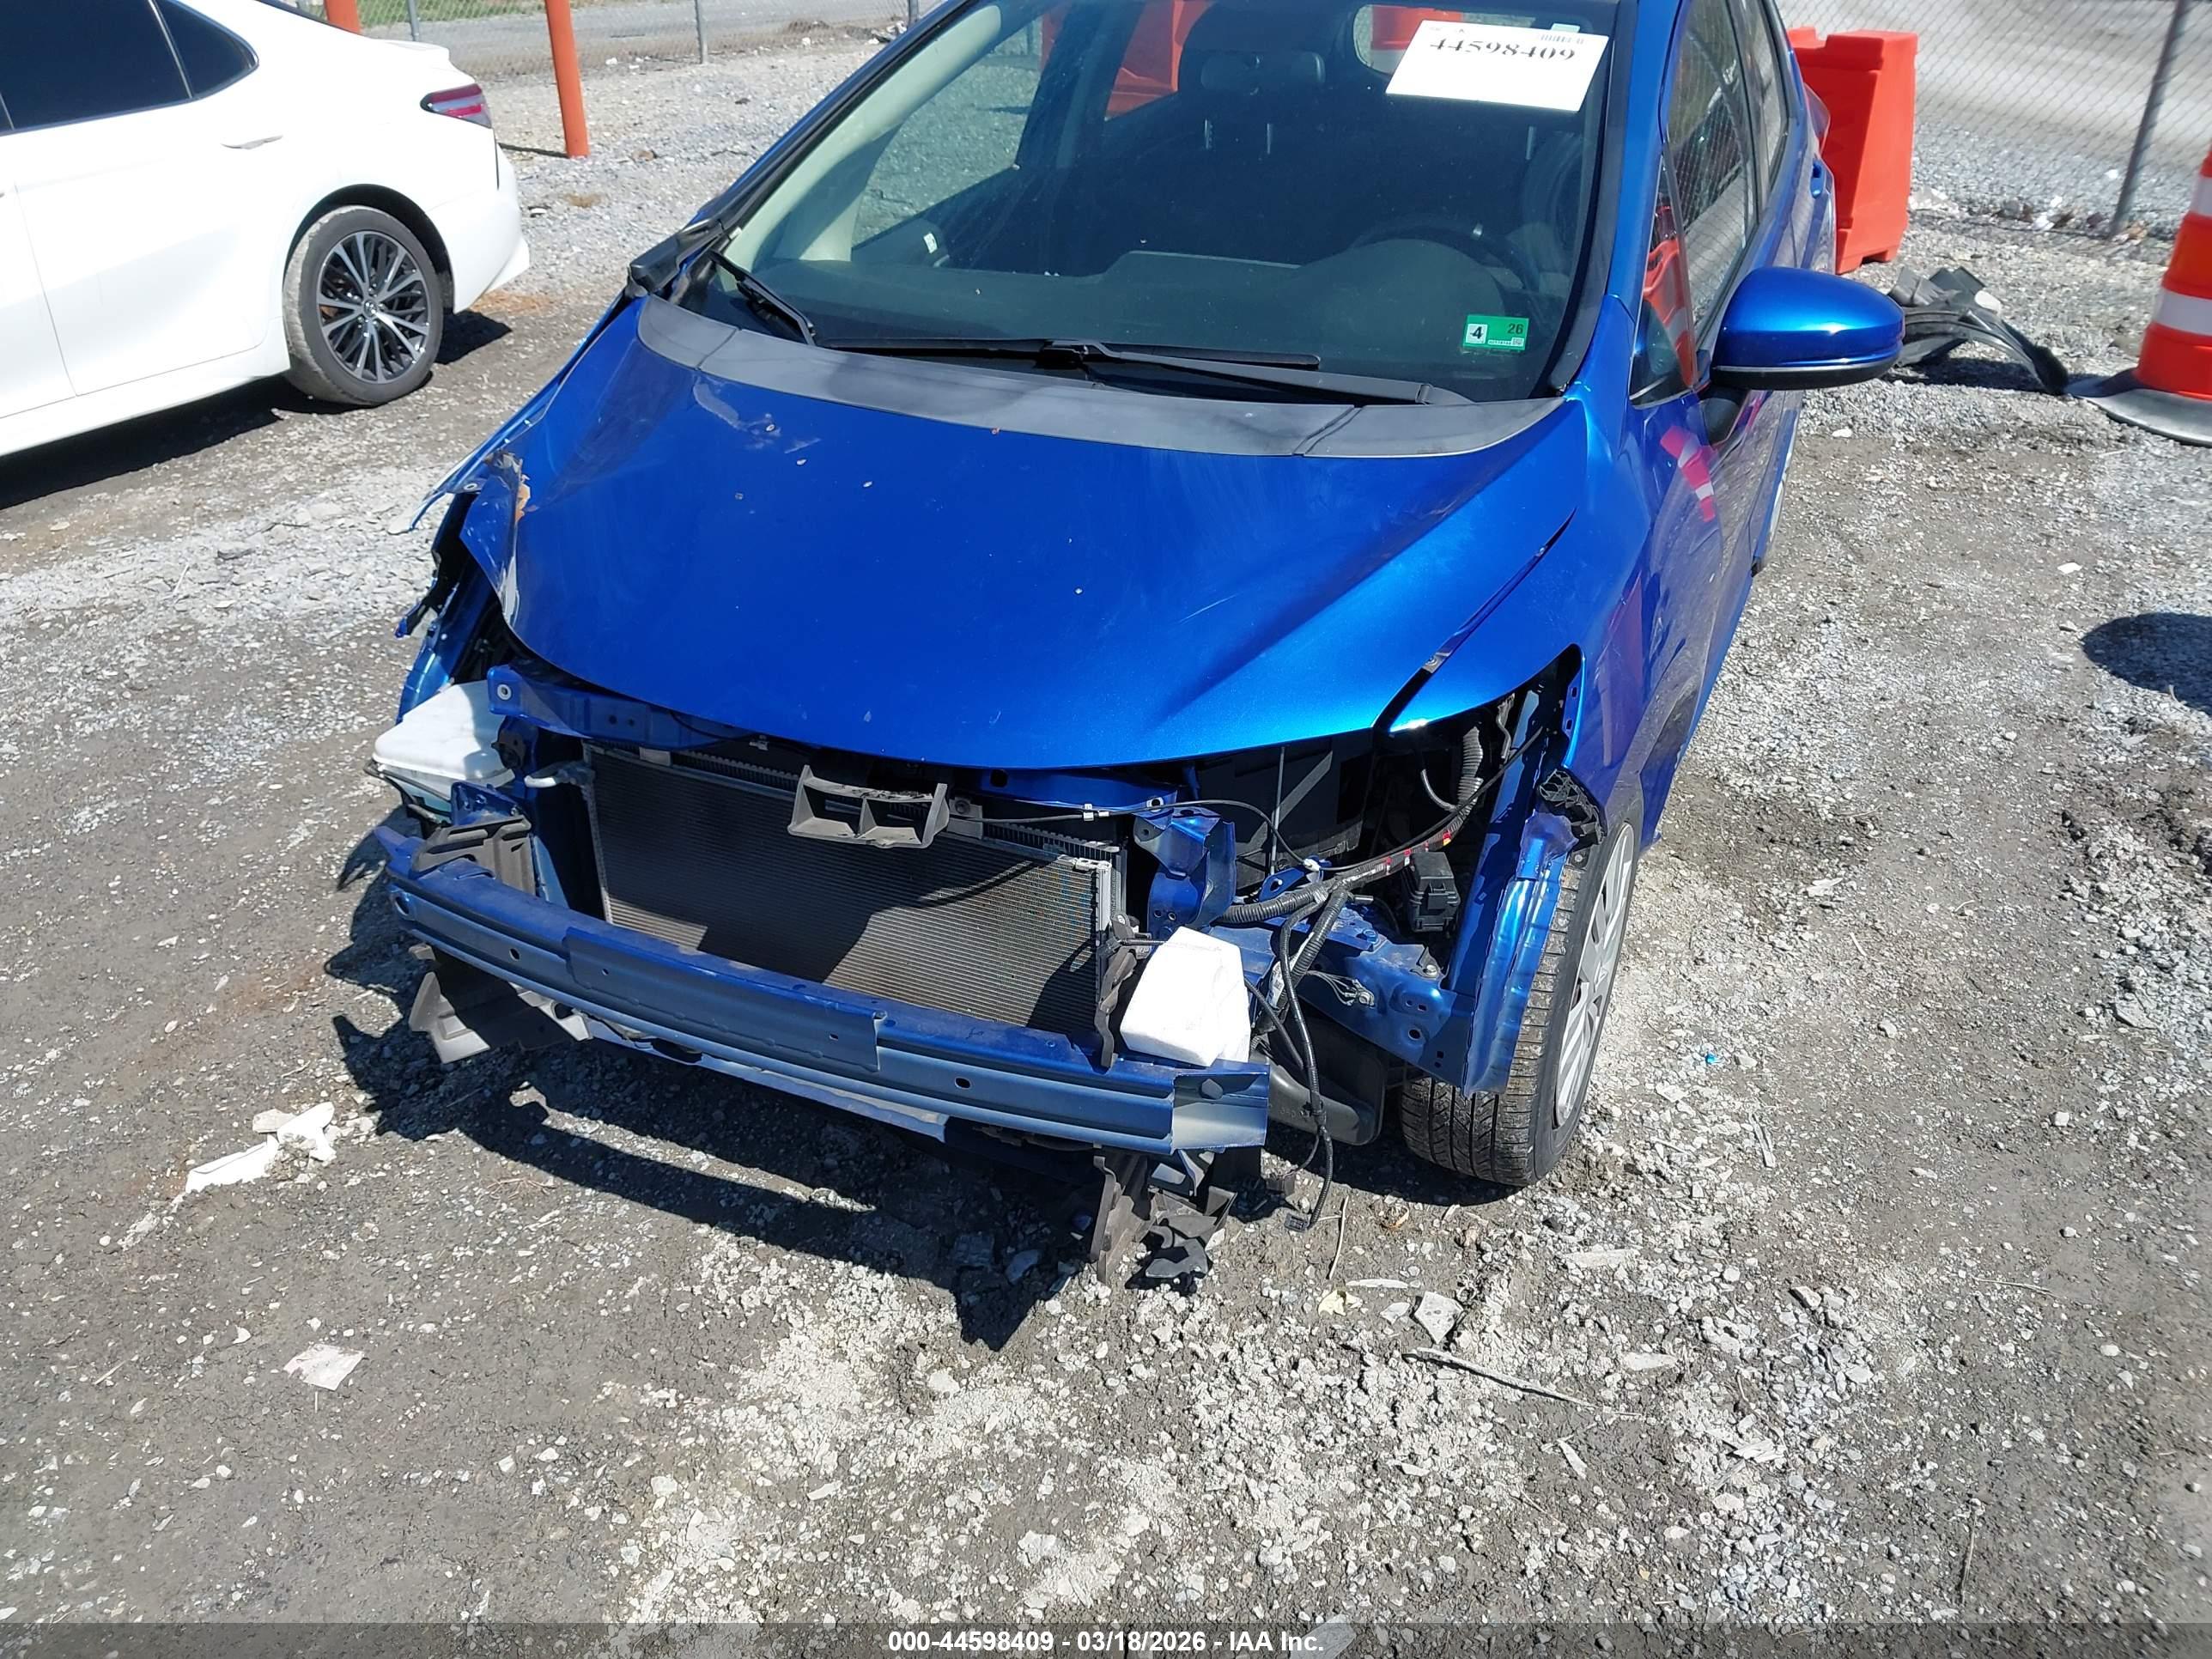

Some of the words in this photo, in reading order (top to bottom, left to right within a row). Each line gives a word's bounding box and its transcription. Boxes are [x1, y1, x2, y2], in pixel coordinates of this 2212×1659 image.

[1430, 38, 1576, 60] 44598409
[1470, 326, 1484, 339] 4
[1508, 323, 1523, 334] 26
